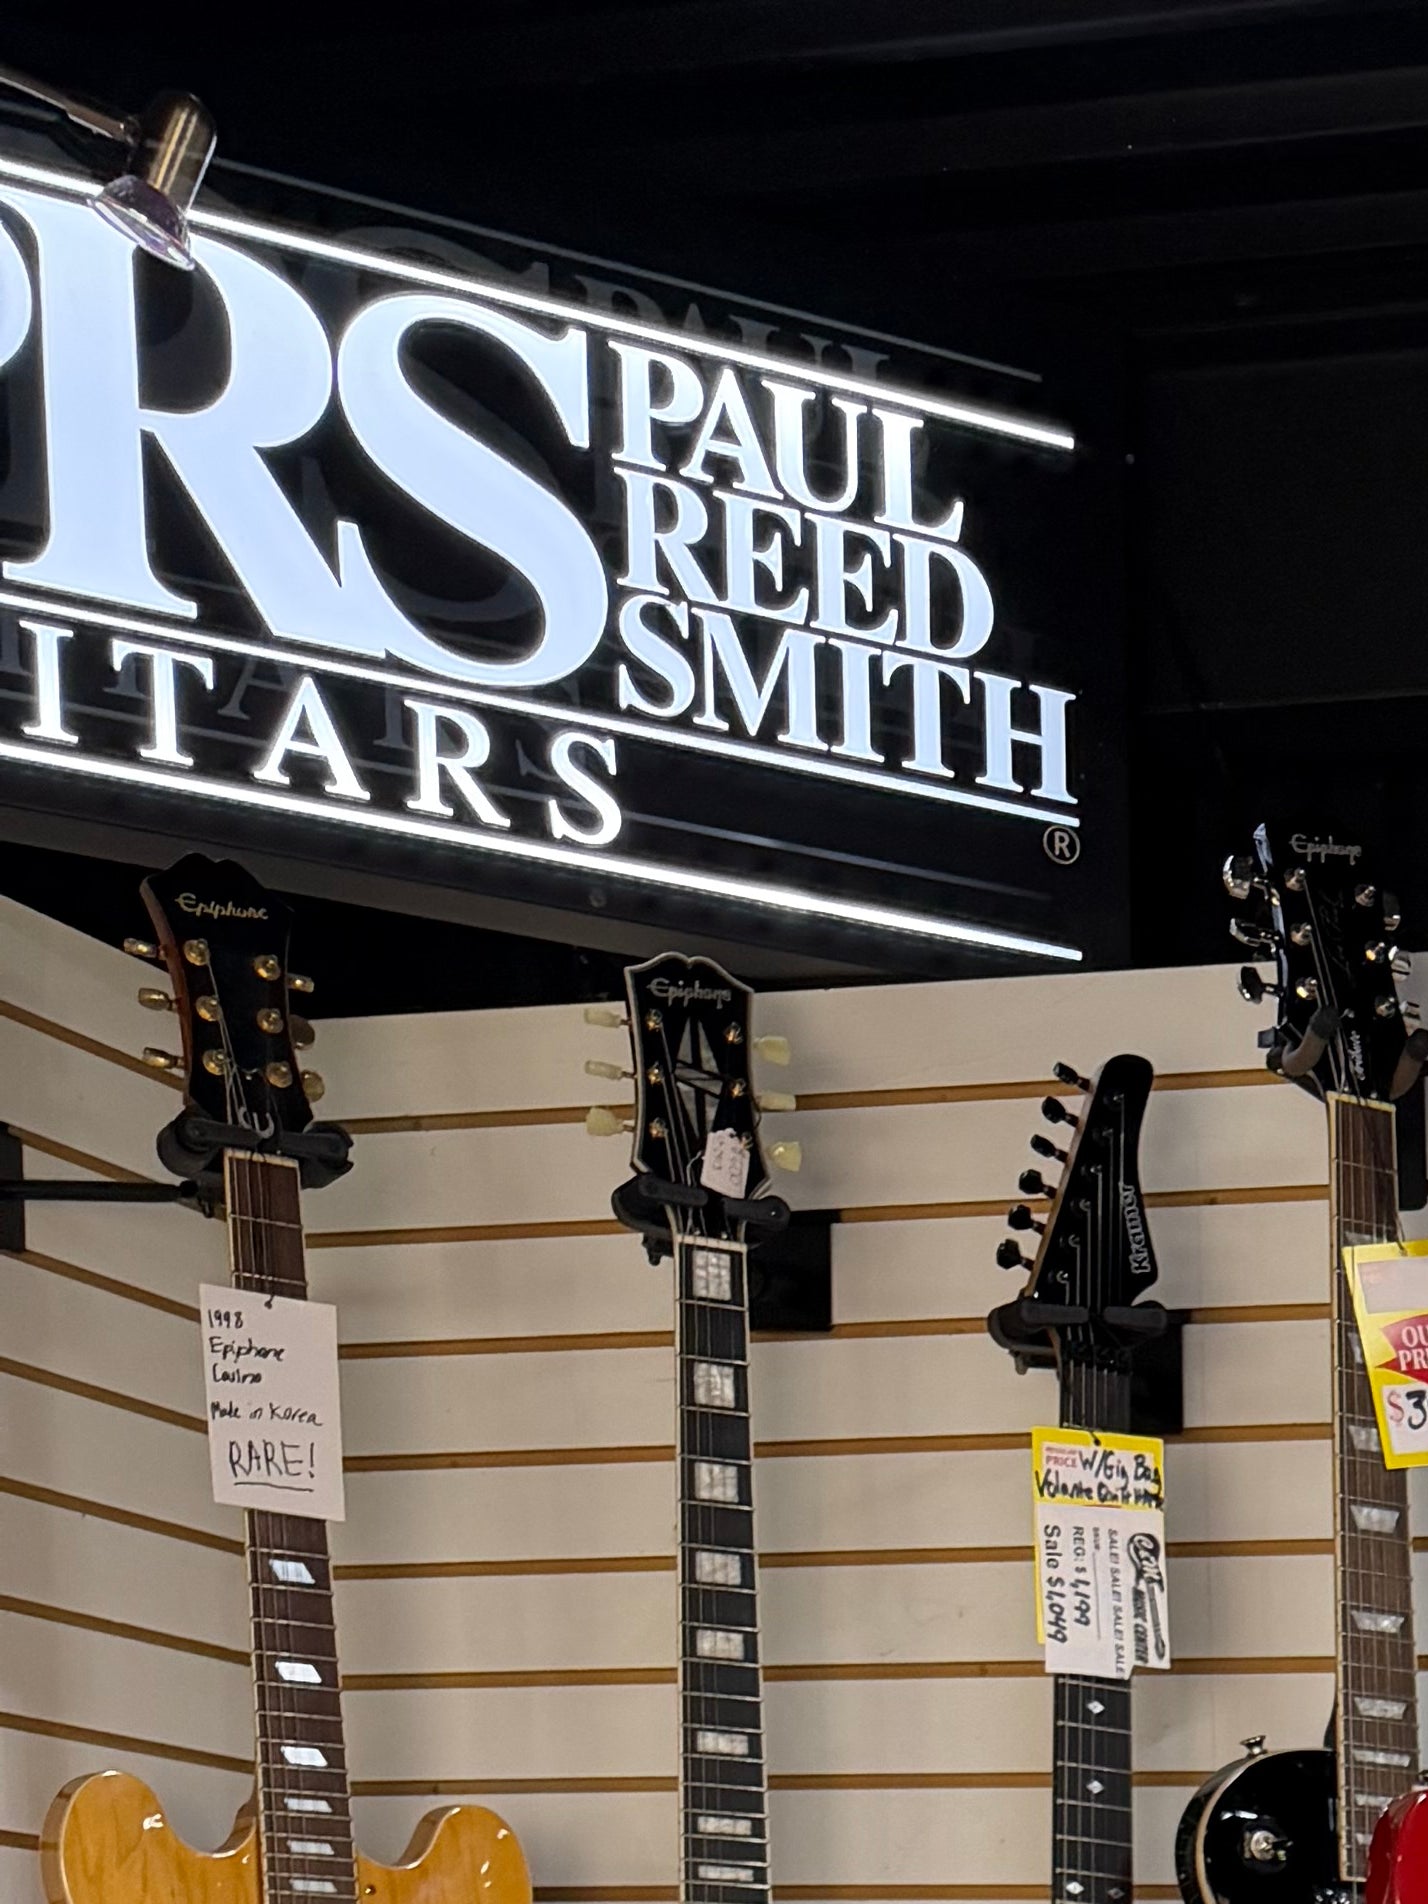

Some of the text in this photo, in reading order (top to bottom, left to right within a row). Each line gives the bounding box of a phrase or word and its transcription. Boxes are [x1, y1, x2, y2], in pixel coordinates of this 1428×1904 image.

[0, 194, 608, 688] RS
[606, 338, 964, 540] PAUL
[614, 466, 996, 660] REED
[617, 594, 1078, 804] SMITH
[174, 892, 269, 920] Epiphone
[646, 977, 732, 1010] Epiphone
[1119, 1183, 1151, 1274] Kramer
[208, 1309, 244, 1329] 1998
[269, 1402, 323, 1427] Korea
[229, 1440, 315, 1479] RARE!
[1072, 1526, 1087, 1561] REG:
[1043, 1524, 1068, 1644] Sale $1,049
[1133, 1587, 1148, 1664] MUSIC CENTER
